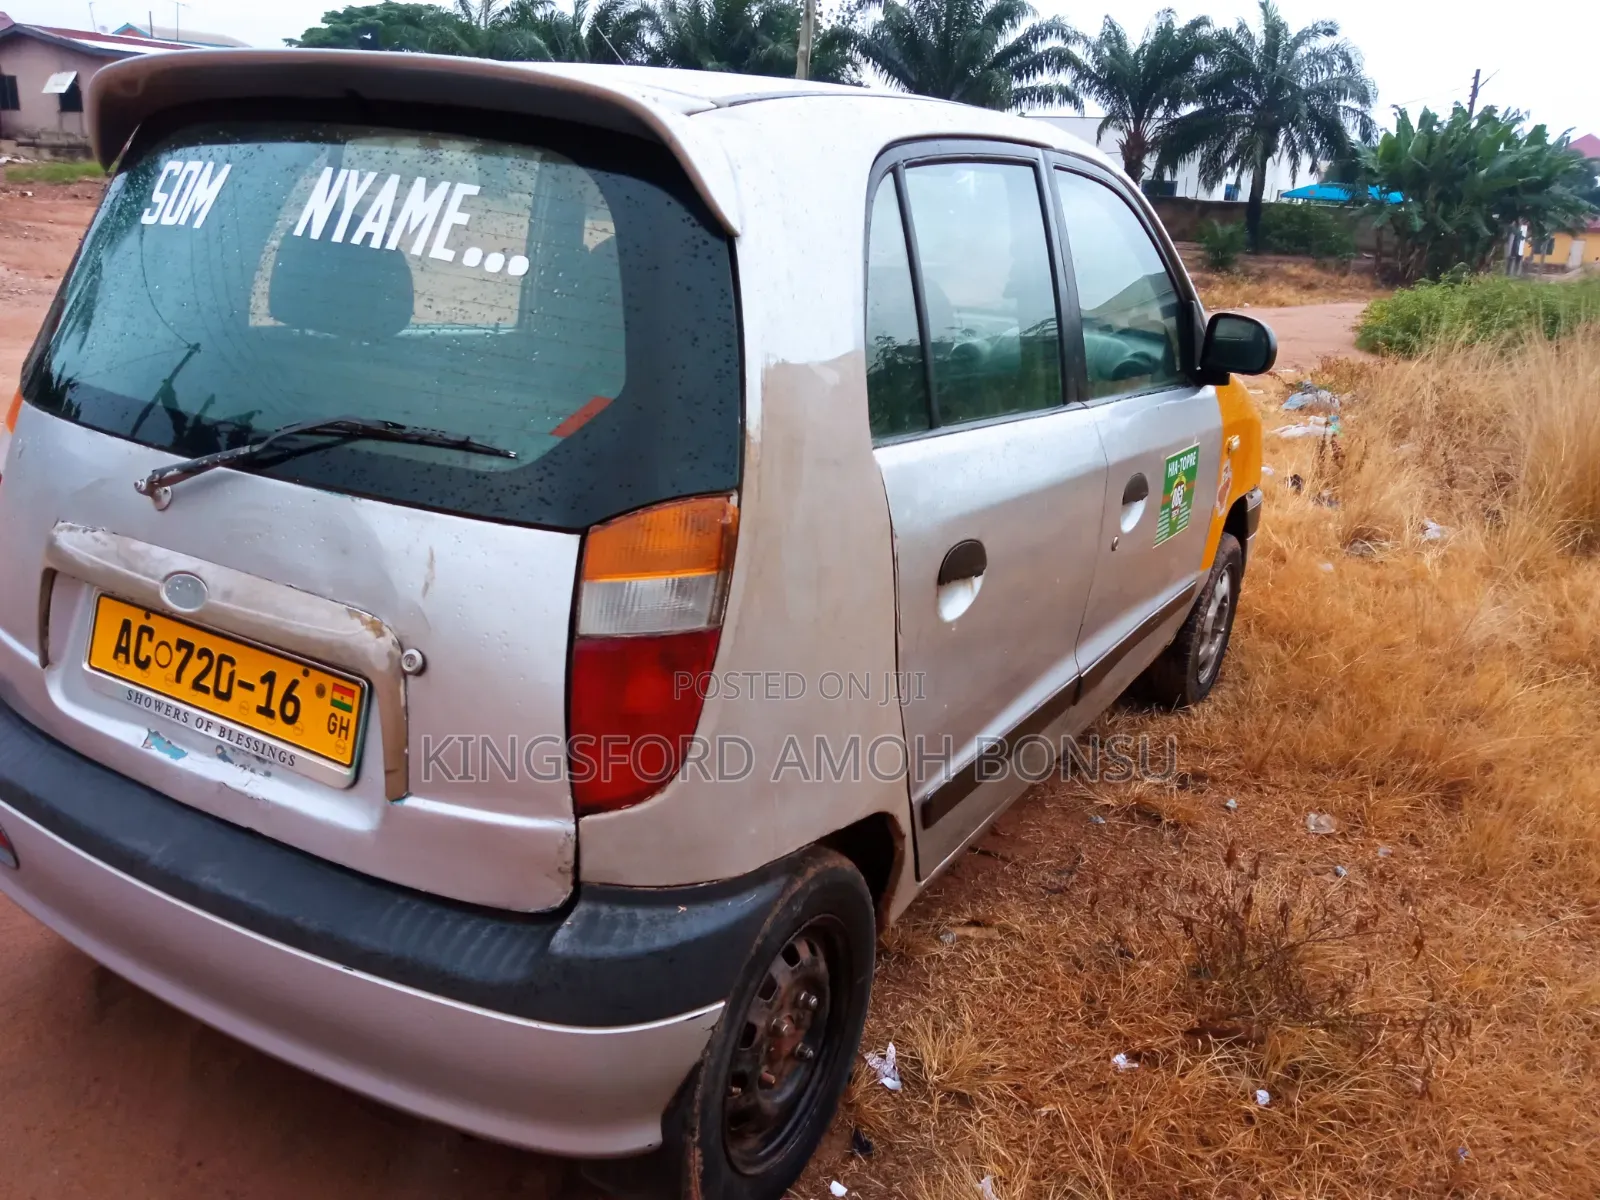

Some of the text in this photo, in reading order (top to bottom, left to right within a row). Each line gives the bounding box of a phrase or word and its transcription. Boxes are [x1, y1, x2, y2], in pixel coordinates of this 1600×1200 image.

[141, 160, 530, 277] SOM NYAME...
[112, 618, 302, 726] AC 720-16
[126, 688, 297, 768] SHOWERS OF BLESSINGS
[327, 711, 351, 741] GH
